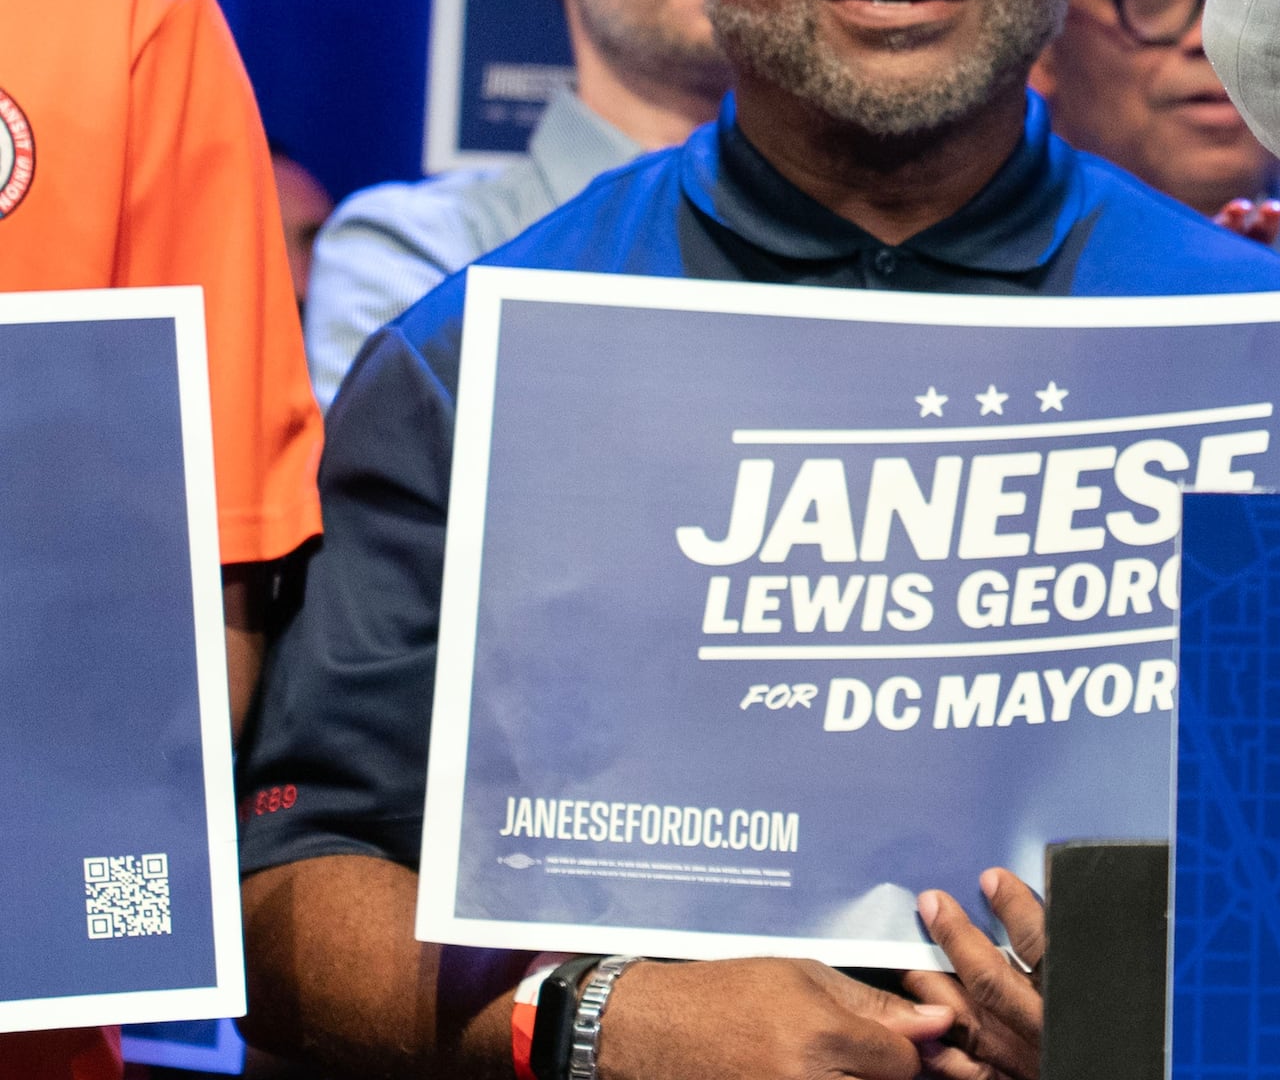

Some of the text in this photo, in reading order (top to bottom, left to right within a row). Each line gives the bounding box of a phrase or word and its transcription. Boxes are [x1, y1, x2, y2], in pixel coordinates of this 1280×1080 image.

[702, 573, 934, 634] LEWIS
[740, 659, 1177, 732] FOR DC MAYOR
[499, 797, 799, 852] JANEESEFORDC.COM
